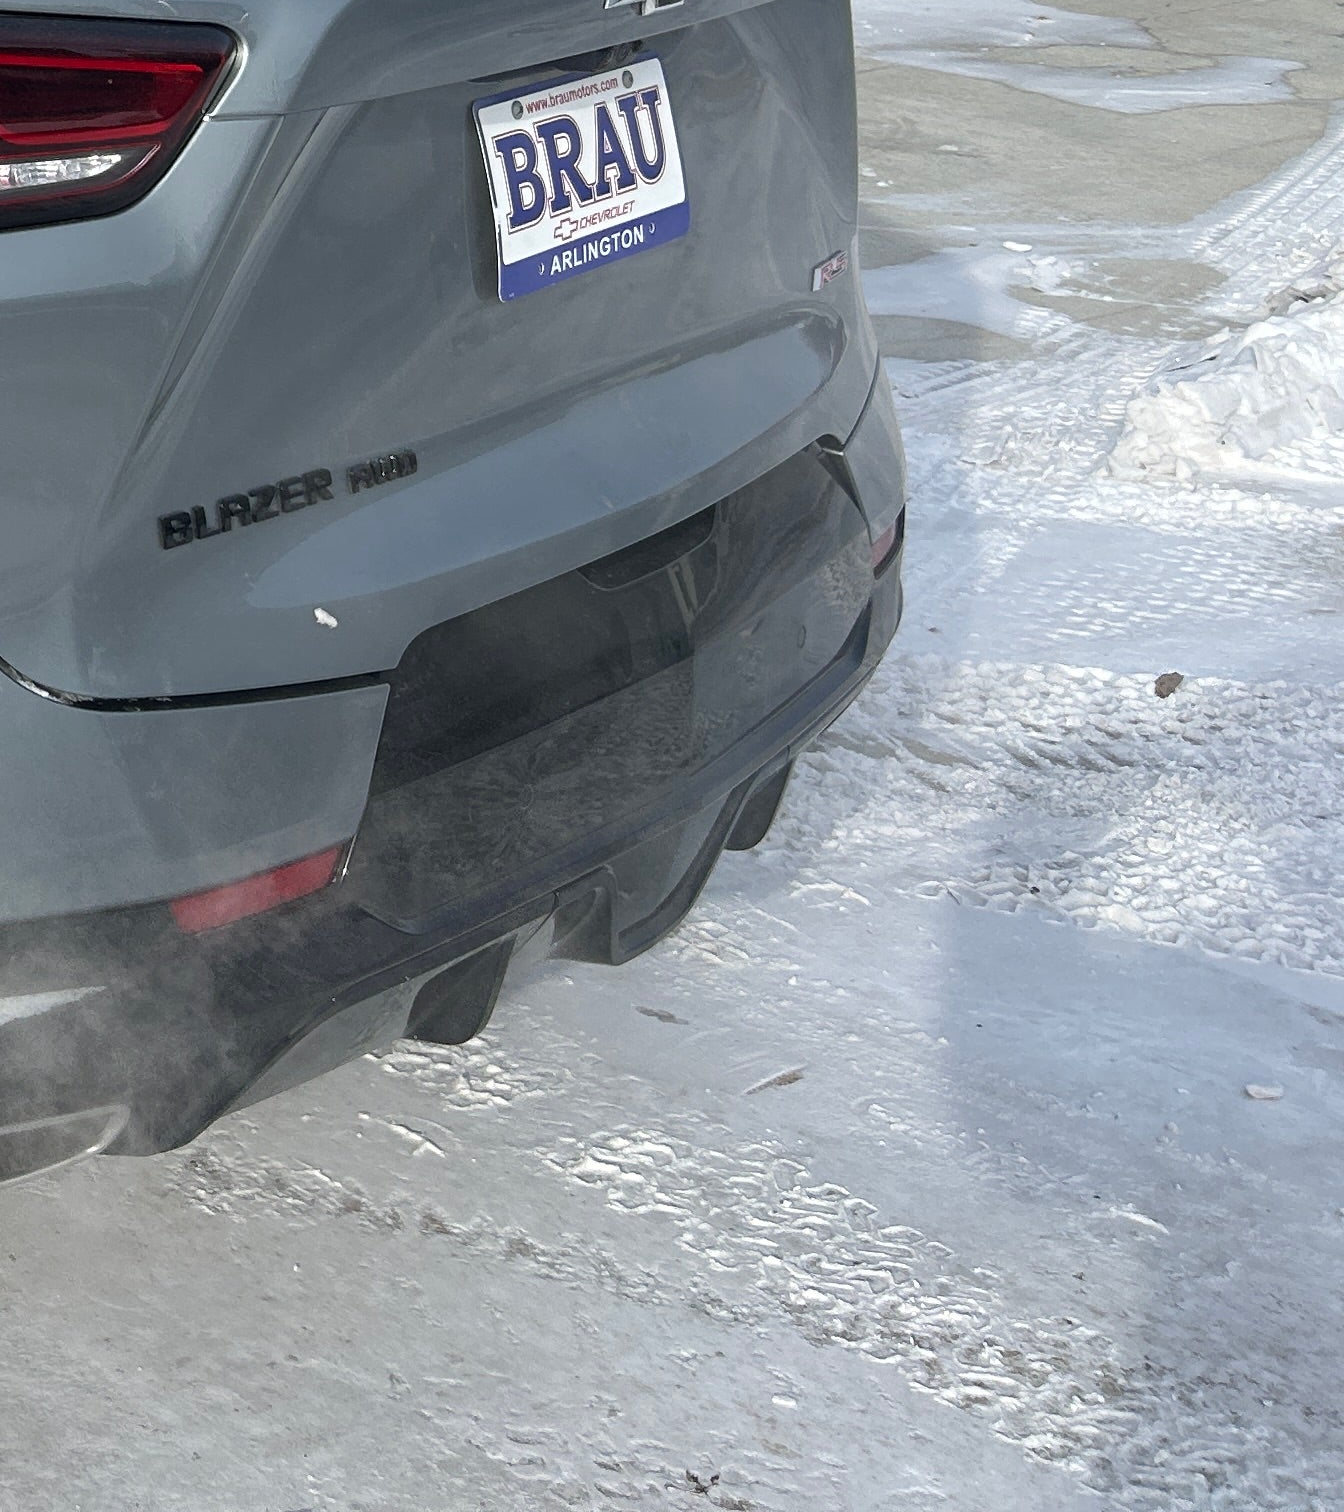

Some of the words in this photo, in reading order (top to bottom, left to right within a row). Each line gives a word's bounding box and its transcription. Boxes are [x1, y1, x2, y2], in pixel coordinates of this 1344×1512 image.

[525, 78, 618, 114] www.braumotors.com
[492, 85, 667, 234] BRAU
[579, 200, 635, 230] CHEVROLET
[550, 224, 644, 275] ARLINGTON
[158, 468, 334, 550] BLAZER
